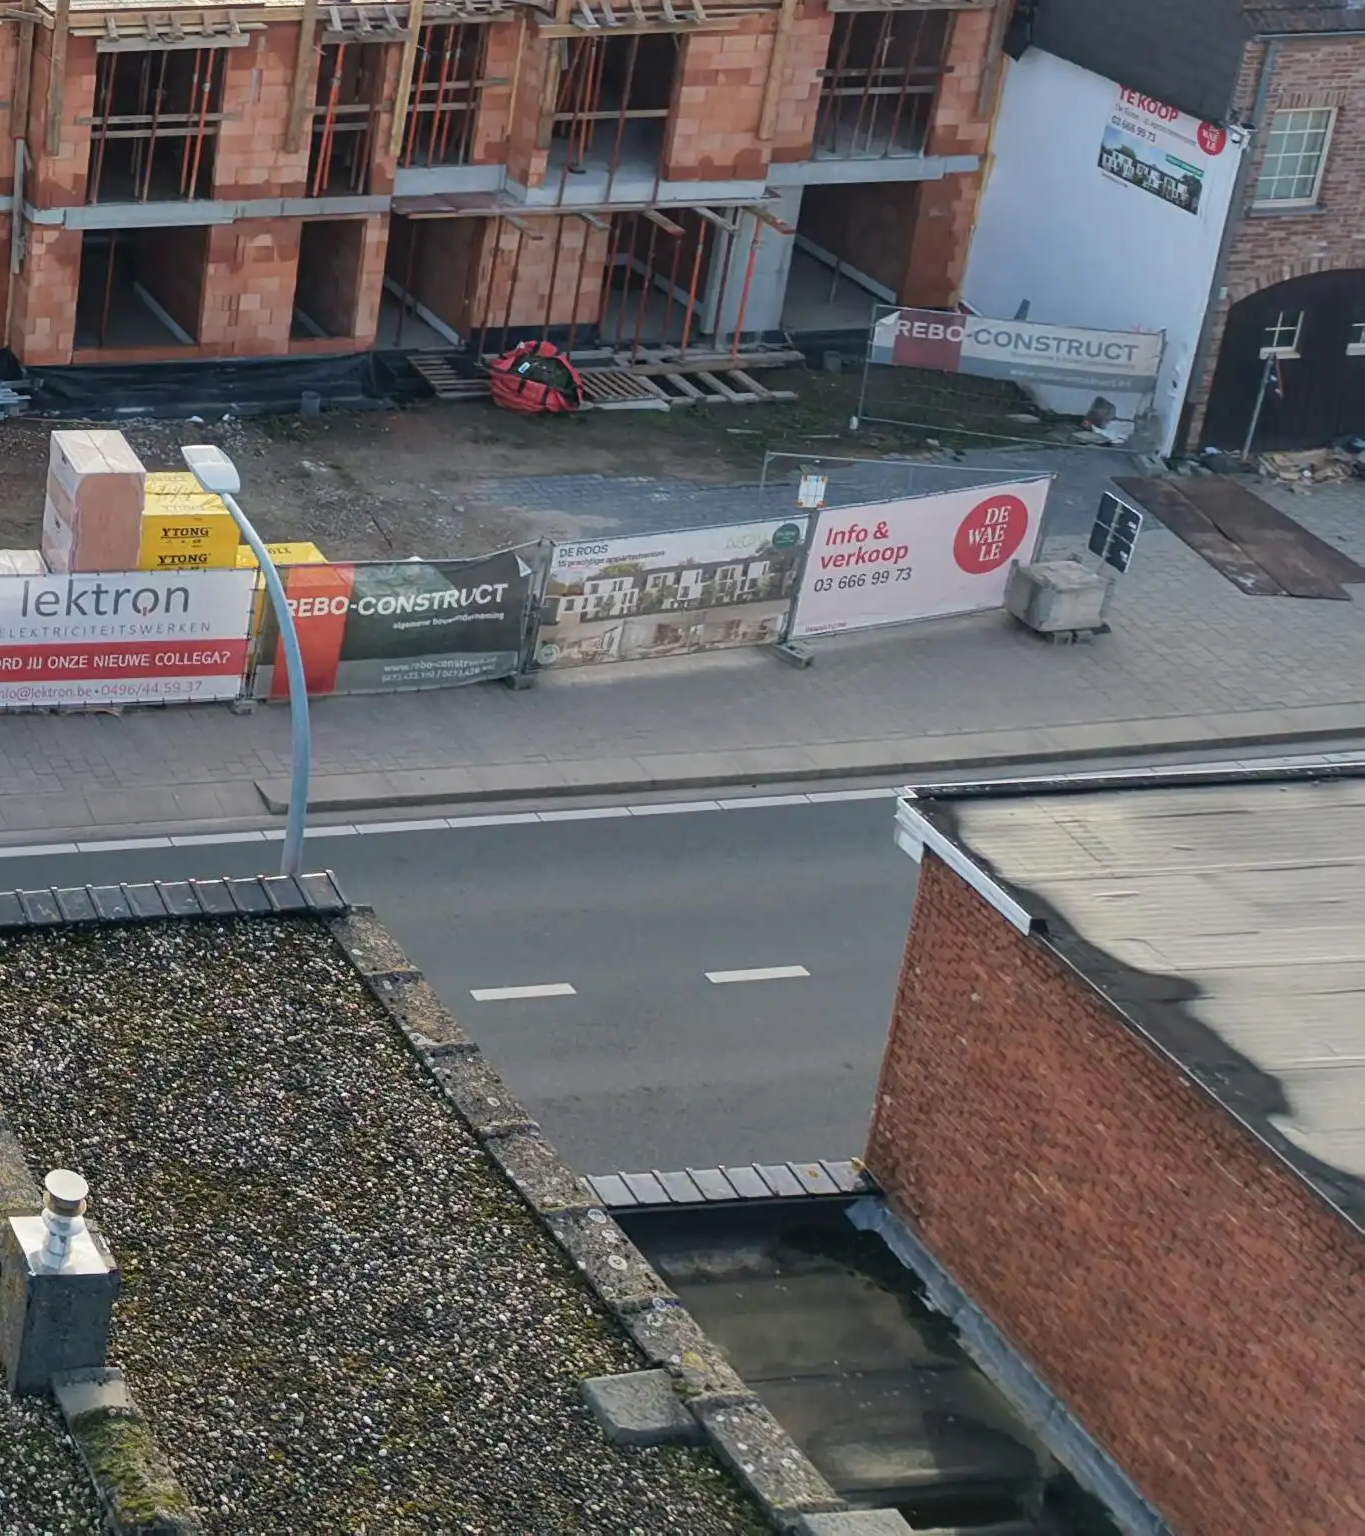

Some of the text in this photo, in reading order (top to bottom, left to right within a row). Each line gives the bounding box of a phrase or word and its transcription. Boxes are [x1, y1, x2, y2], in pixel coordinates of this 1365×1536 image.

[1119, 86, 1179, 122] TE KOOP
[895, 320, 1139, 361] REBO-CONSTRUCT
[985, 506, 1011, 524] DE
[162, 527, 209, 537] YTONG
[825, 522, 889, 546] Info &
[968, 524, 1005, 543] WAE
[158, 554, 208, 564] YTONG
[559, 544, 609, 558] DE ROOS
[821, 544, 909, 570] verkoop
[978, 543, 1002, 562] LE
[814, 567, 912, 592] 03 666 99 73
[21, 579, 190, 618] lektron
[0, 622, 211, 639] ELEKTRICITEITSWERKEN
[25, 657, 43, 670] JIJ
[48, 655, 88, 669] ONZE
[94, 654, 151, 667] NIEUWE
[155, 650, 231, 665] COLLEGA?
